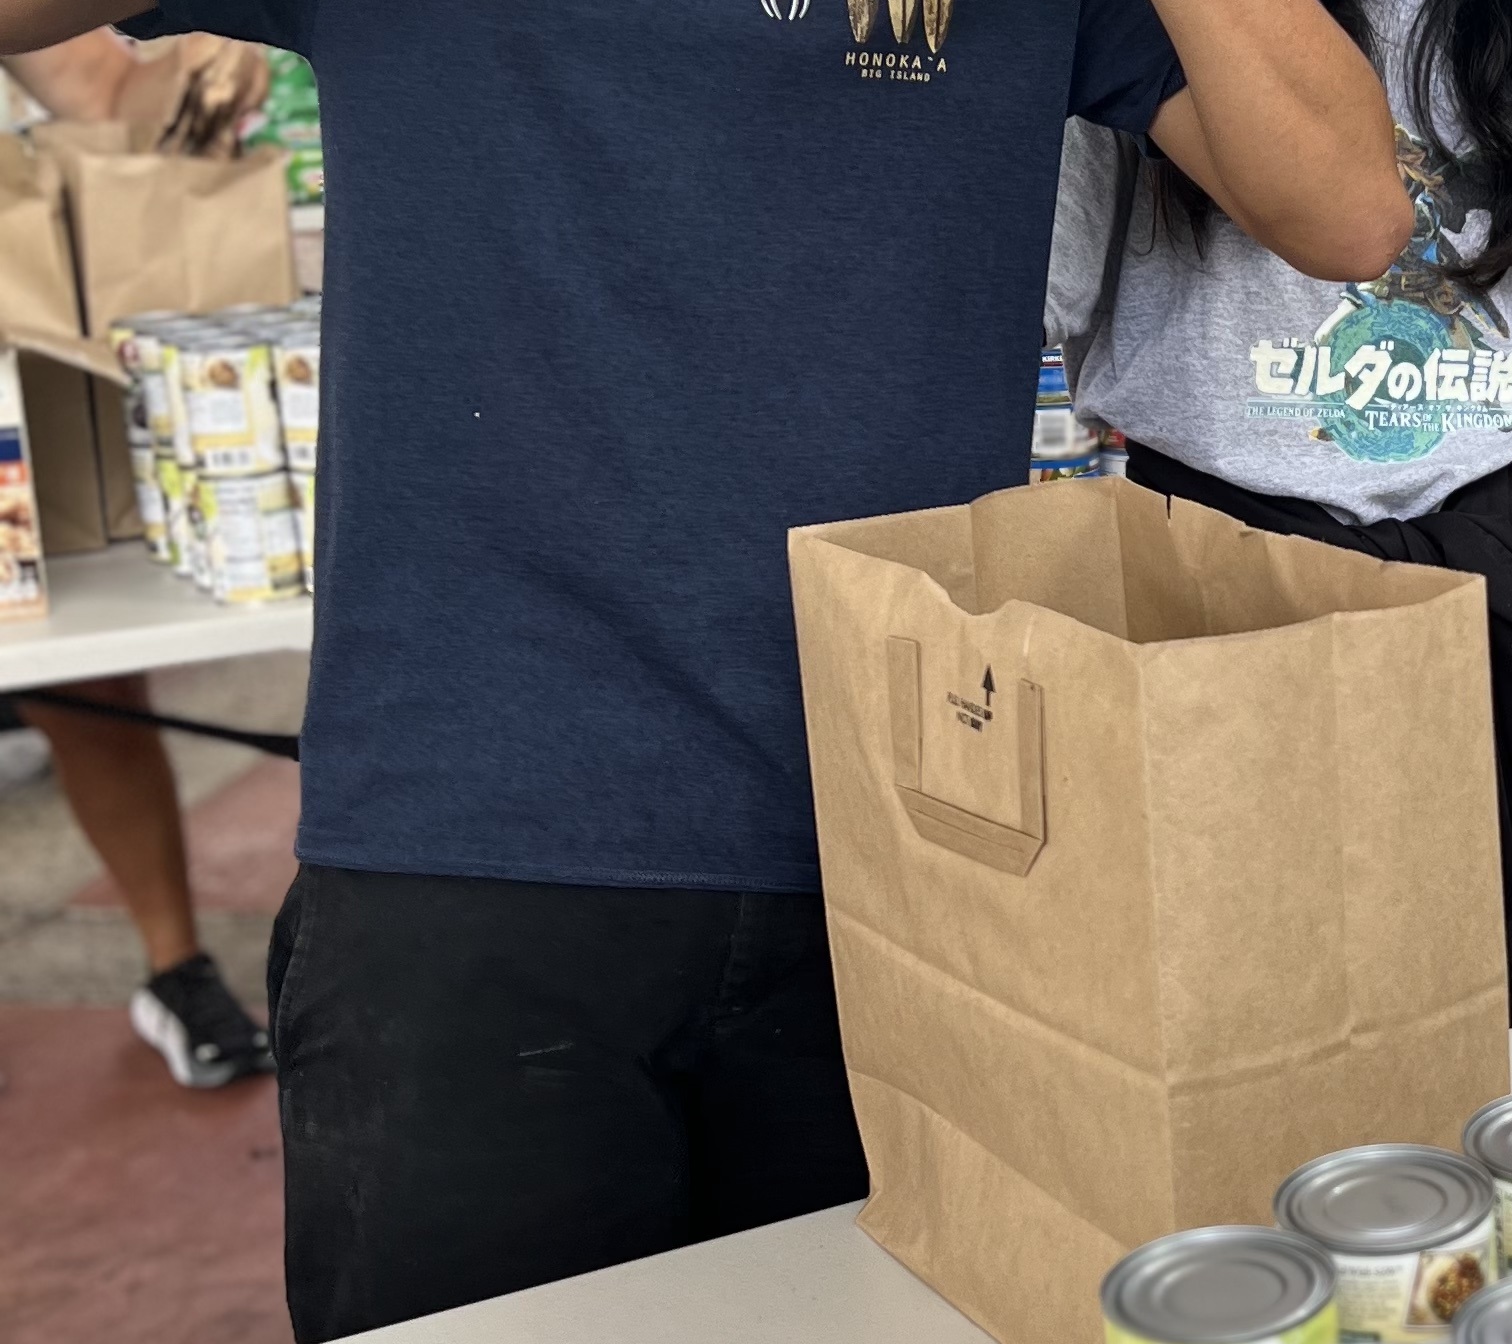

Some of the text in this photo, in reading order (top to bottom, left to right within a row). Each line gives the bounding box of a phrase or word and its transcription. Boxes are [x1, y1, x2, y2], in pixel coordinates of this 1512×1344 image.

[861, 68, 931, 82] BIG ISLAND
[1247, 406, 1345, 419] THE LEGEND OF ZELDA
[1423, 413, 1433, 422] OF
[1365, 410, 1422, 431] TEARS
[1423, 422, 1440, 432] THE
